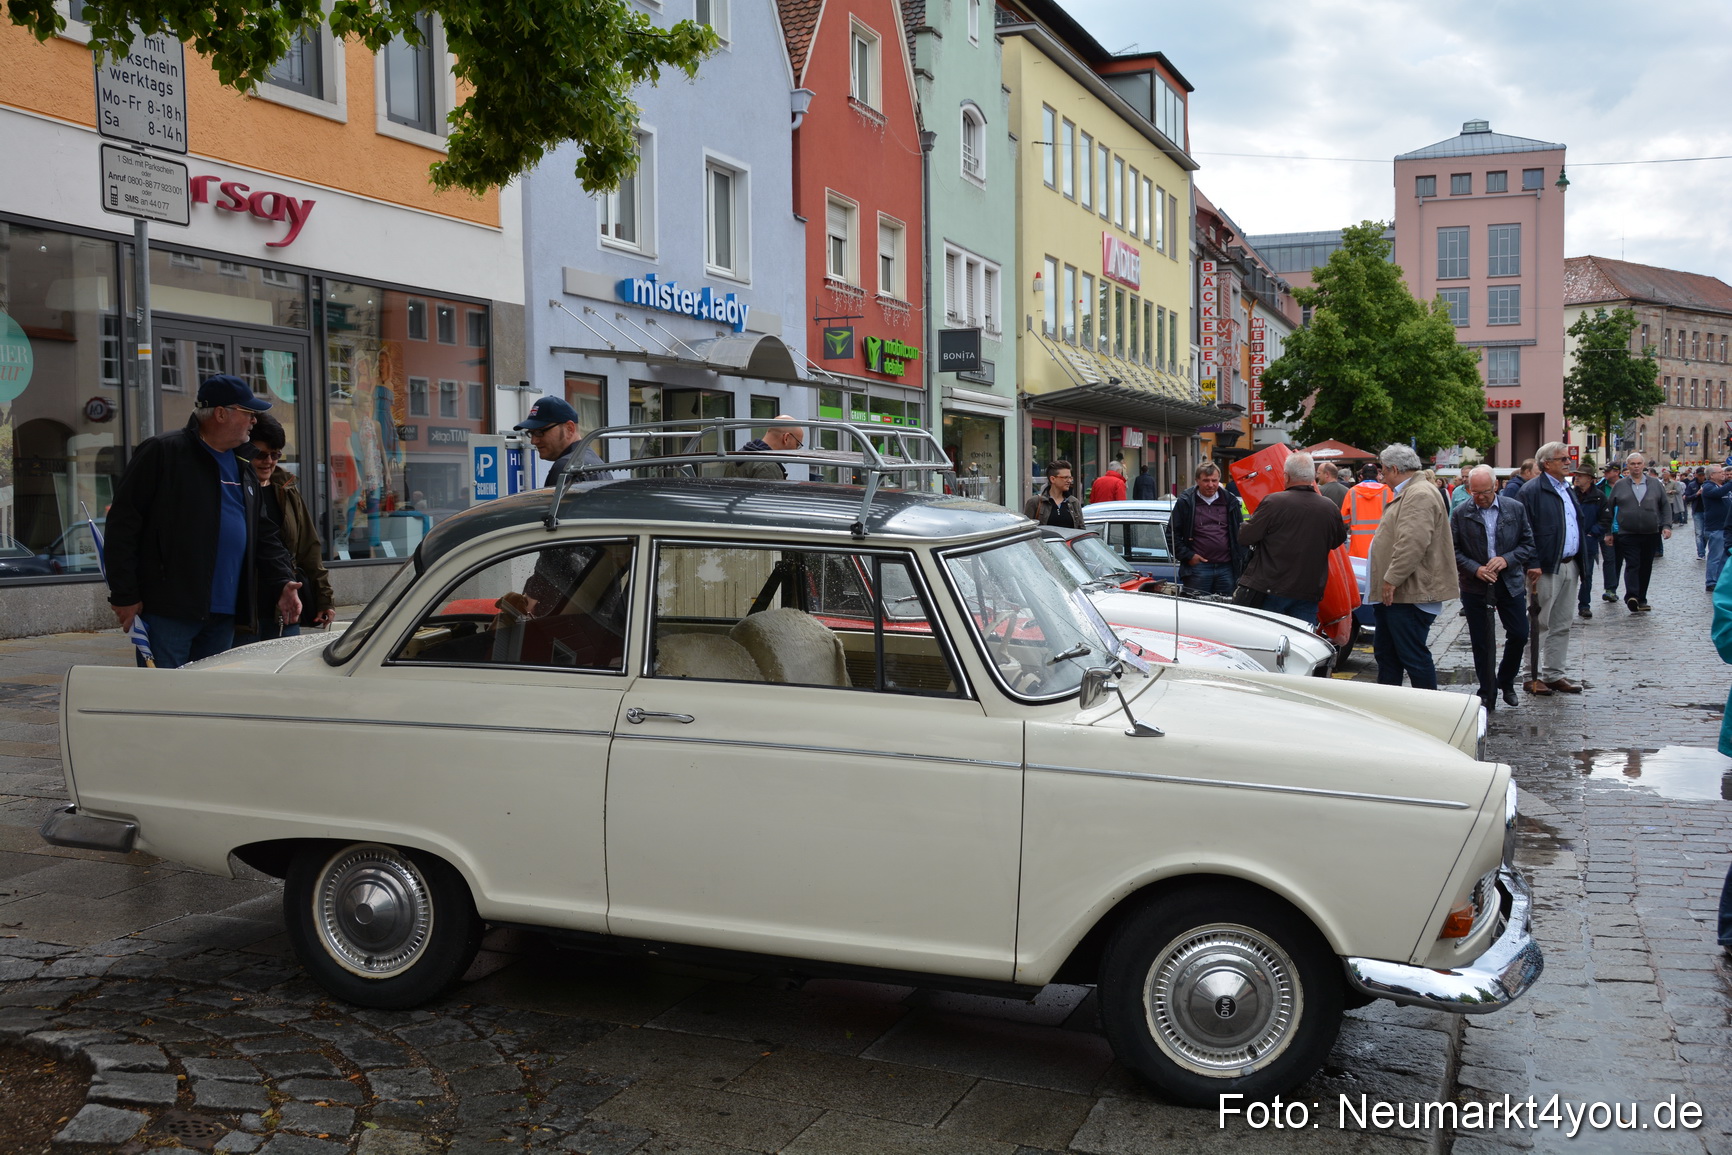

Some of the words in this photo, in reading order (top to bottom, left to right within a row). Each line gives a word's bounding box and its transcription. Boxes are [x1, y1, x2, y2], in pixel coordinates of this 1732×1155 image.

[144, 37, 166, 54] mit
[109, 67, 173, 97] werktags
[104, 110, 120, 127] Sa
[122, 155, 134, 166] Std.
[135, 160, 144, 169] mit
[144, 161, 175, 176] Parkschein
[108, 171, 126, 182] Anruf
[141, 170, 152, 178] oder
[124, 193, 139, 205] SMS
[140, 198, 149, 206] an
[142, 189, 152, 197] oder
[190, 175, 316, 247] rsay
[884, 338, 919, 360] mobilcom
[884, 358, 905, 377] debitel
[1202, 380, 1216, 391] café
[1485, 398, 1521, 408] kasse
[851, 410, 866, 421] GRAVIS
[480, 454, 494, 477] P
[477, 482, 497, 495] SCHEINE
